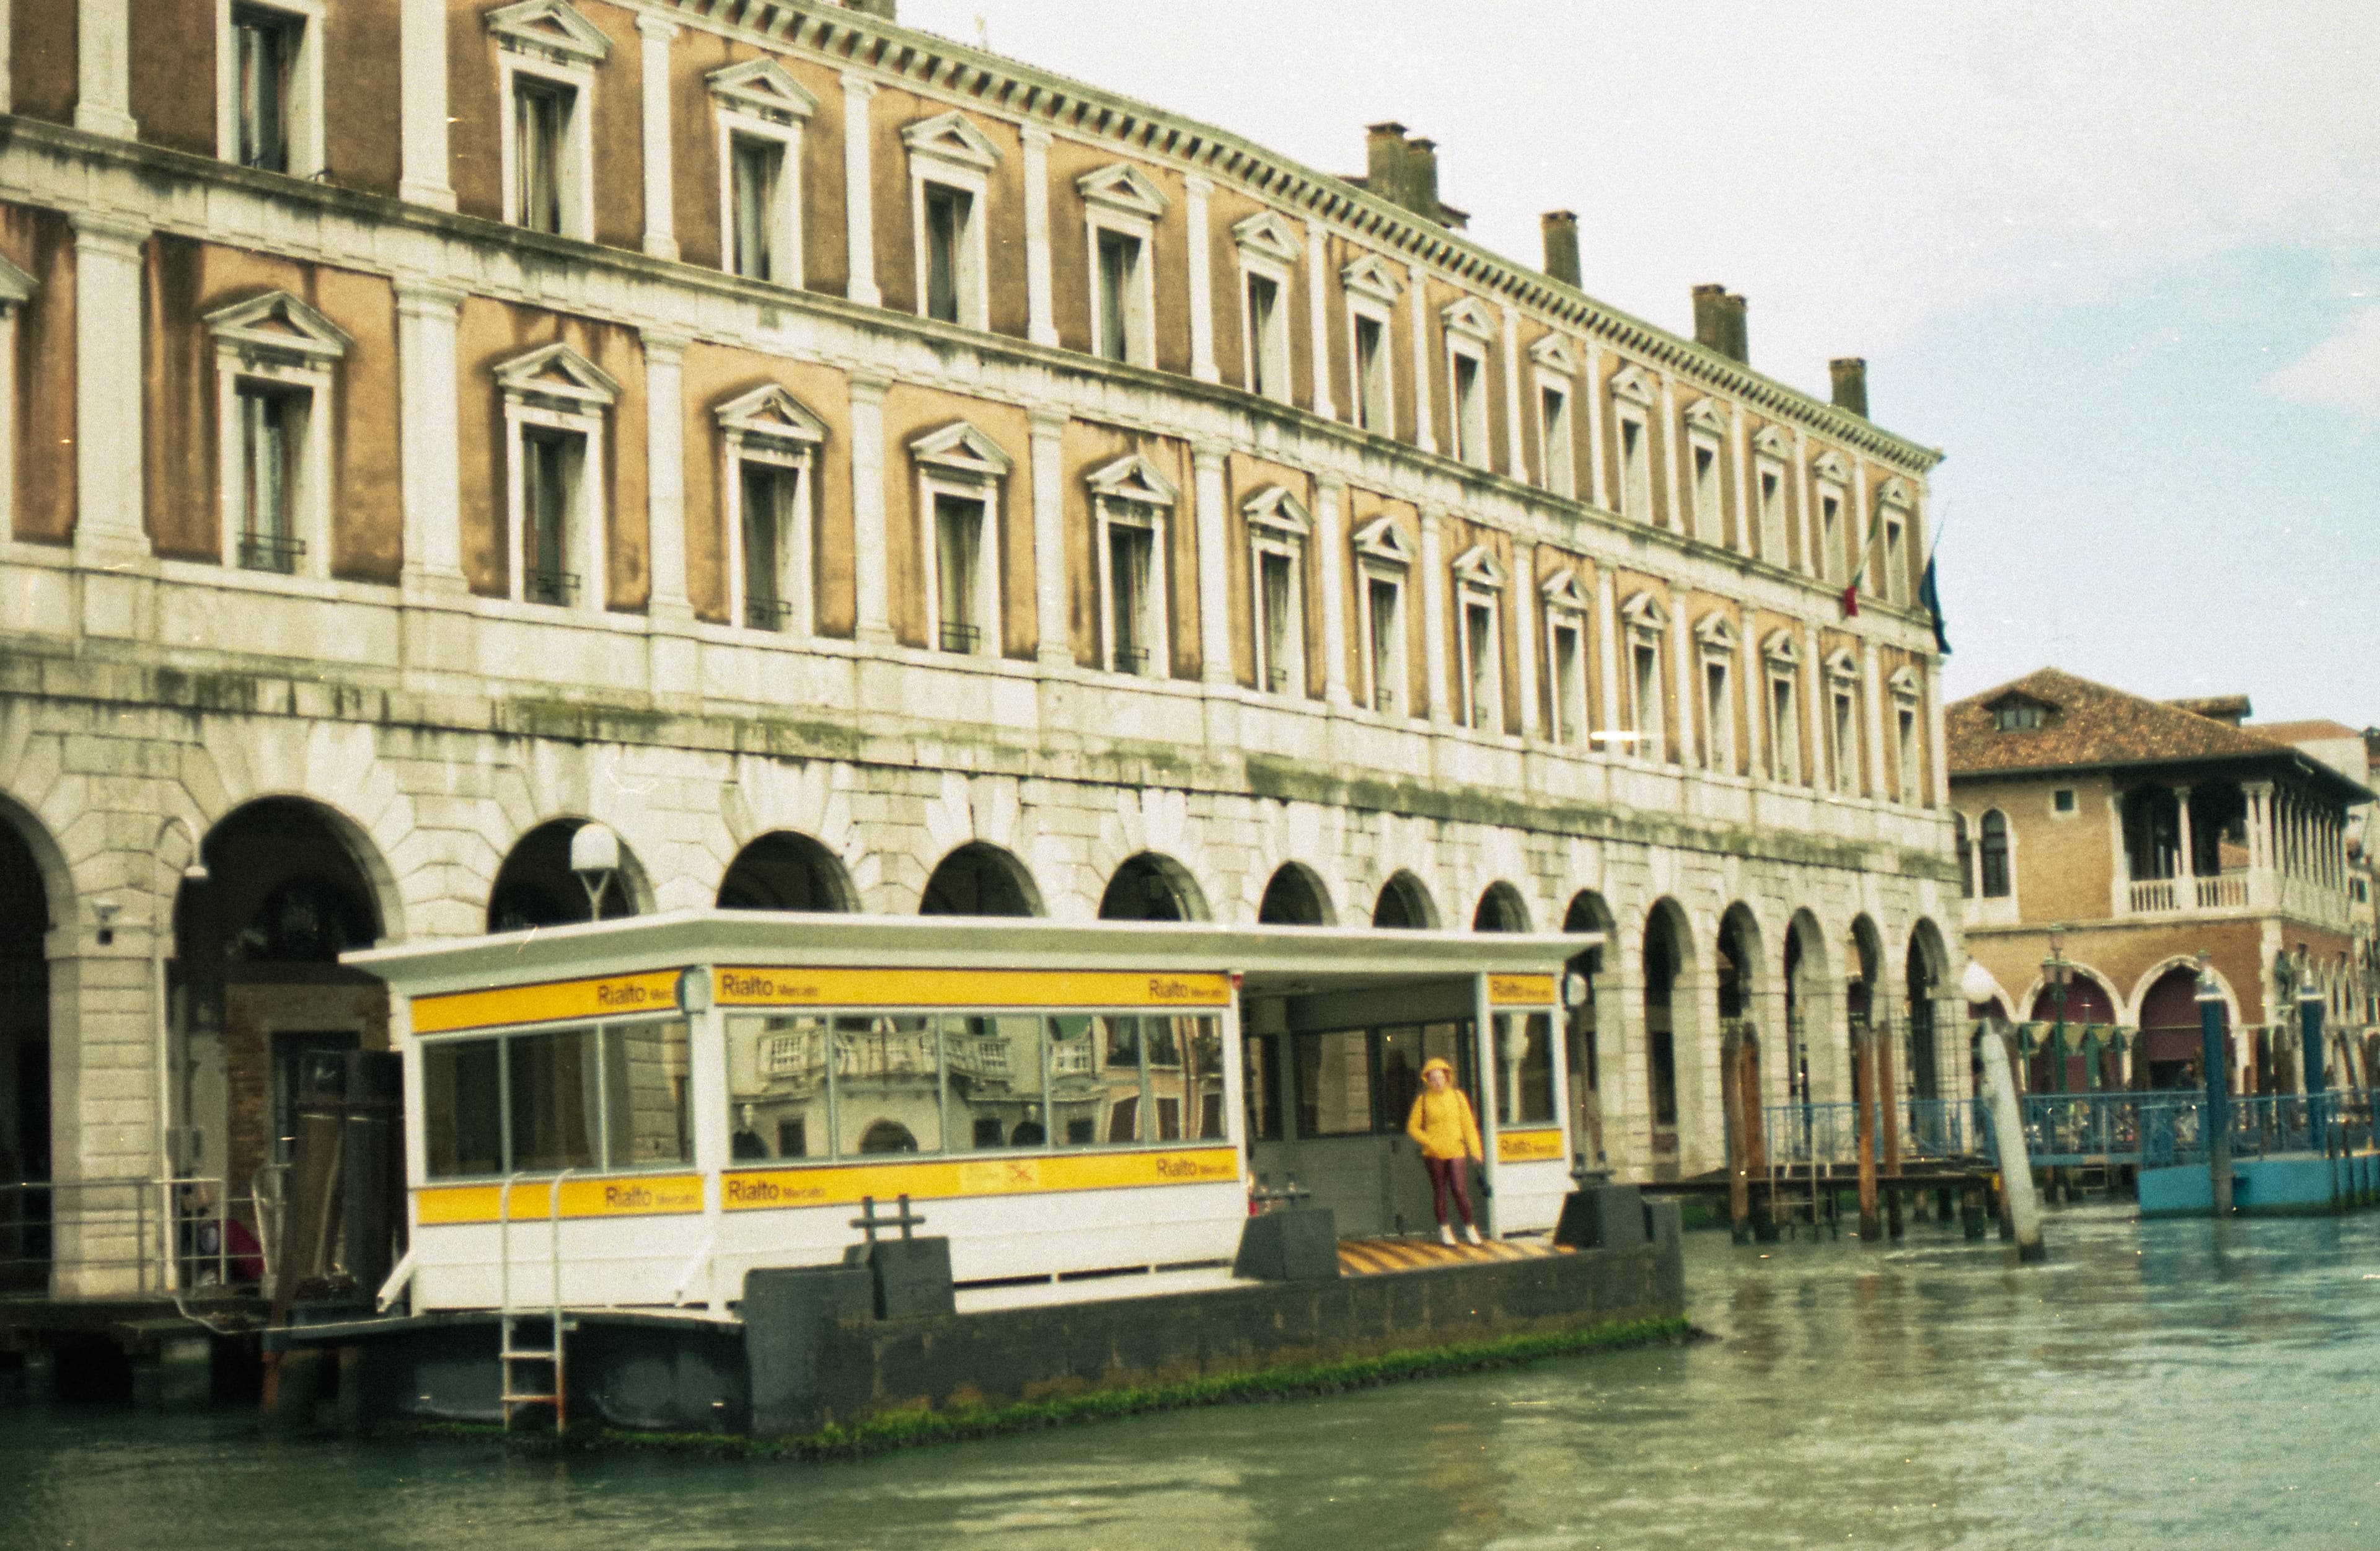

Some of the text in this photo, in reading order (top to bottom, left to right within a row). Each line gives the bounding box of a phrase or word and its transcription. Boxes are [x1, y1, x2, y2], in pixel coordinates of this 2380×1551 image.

[599, 985, 645, 1005] Rialto
[722, 974, 774, 996] Rialto
[1149, 979, 1188, 997] Rialto
[606, 1186, 651, 1208] Rialto
[728, 1180, 779, 1201] Rialto
